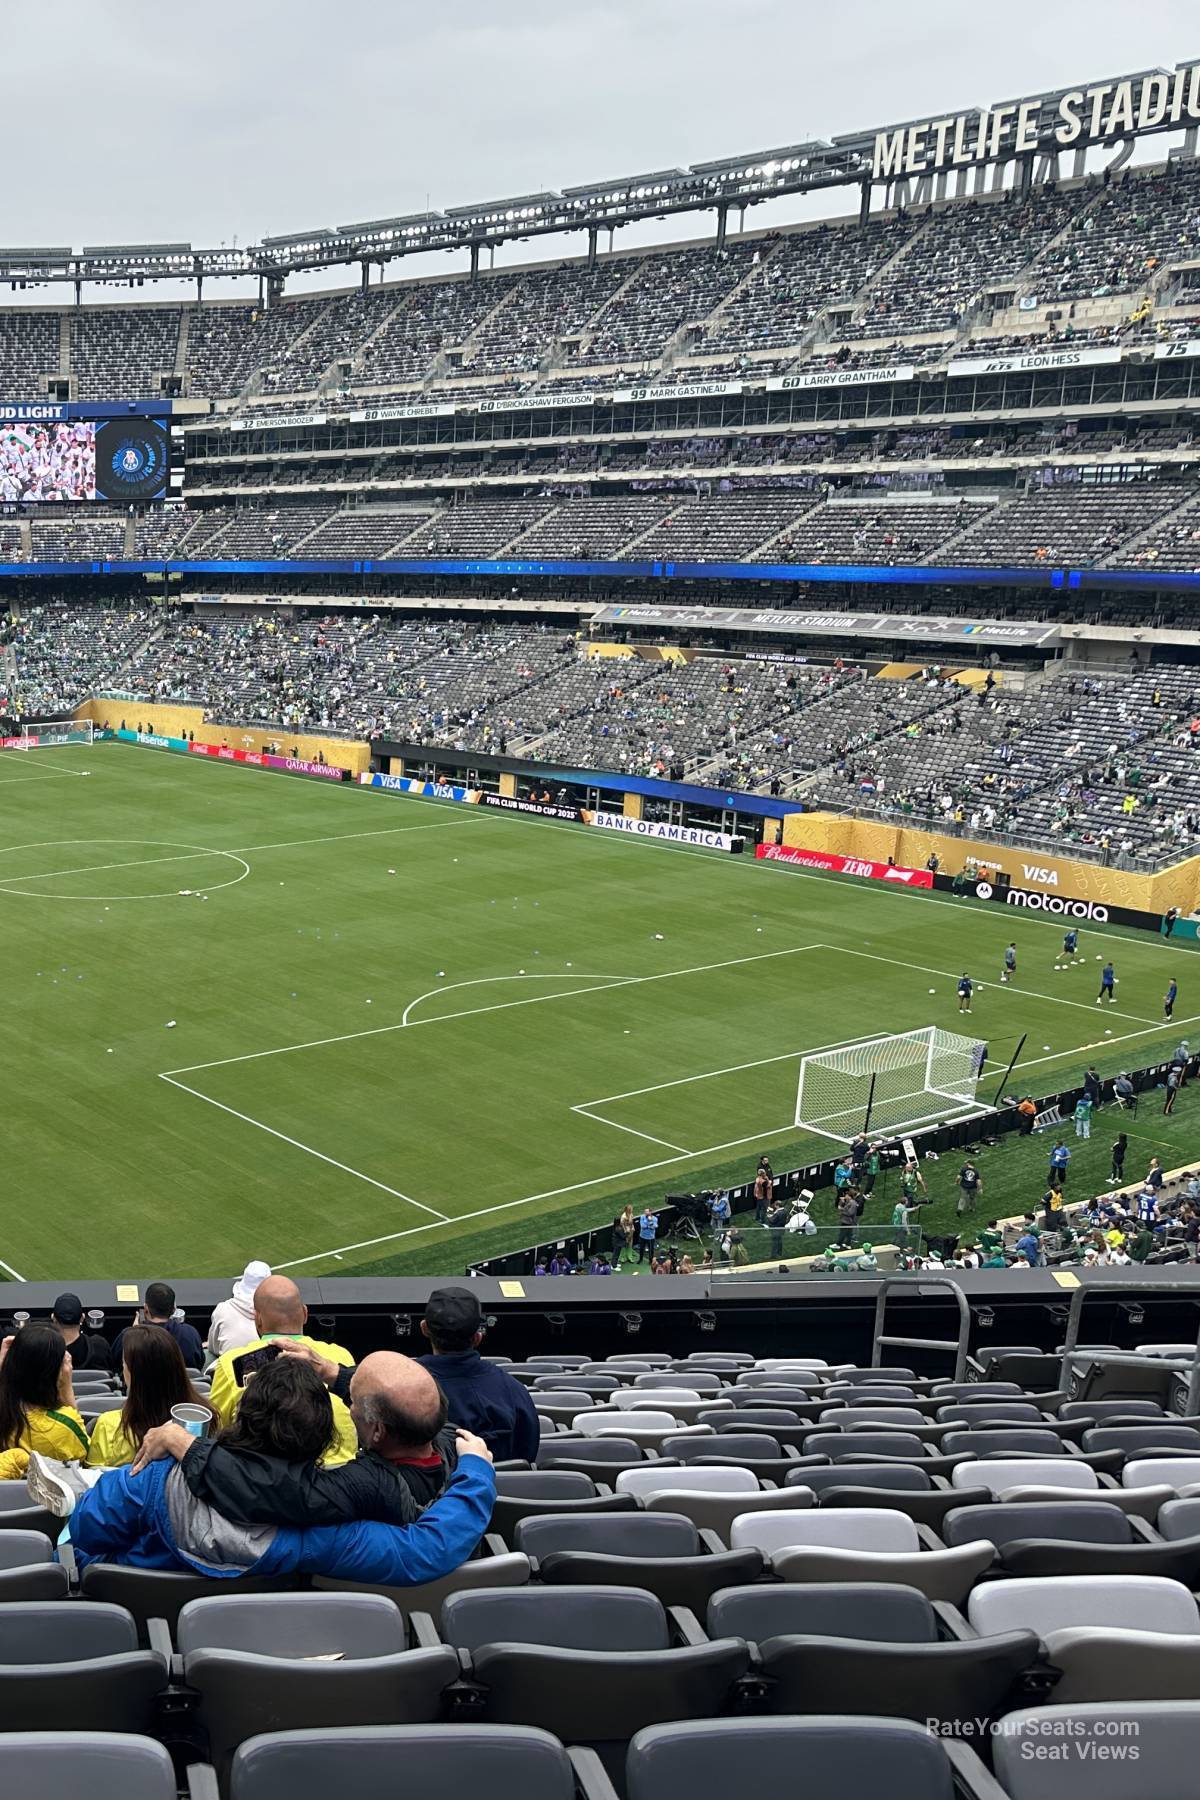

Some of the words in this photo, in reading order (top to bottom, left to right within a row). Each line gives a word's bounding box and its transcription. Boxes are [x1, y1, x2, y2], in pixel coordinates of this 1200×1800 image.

[872, 100, 1043, 180] METLIFE
[1165, 342, 1188, 357] 75
[981, 360, 1015, 373] JETS
[1020, 356, 1053, 369] LEON
[1055, 353, 1081, 365] HESS
[781, 376, 800, 389] 60
[803, 373, 837, 386] LARRY
[838, 368, 898, 384] GRANTHAM
[630, 389, 647, 400] 99
[650, 388, 676, 398] MARK
[677, 384, 727, 396] GASTINEAU
[480, 401, 495, 412] 60
[551, 394, 592, 406] FERGUSON
[18, 406, 63, 418] LIGHT
[364, 410, 378, 420] 80
[380, 408, 406, 418] WAYNE
[406, 406, 439, 417] CHREBET
[242, 419, 254, 429] 32
[255, 418, 287, 428] EMERSON
[287, 416, 314, 426] BOOZER
[628, 608, 662, 617] MetLife
[751, 614, 799, 625] METLIFE
[800, 617, 857, 628] STADIUM
[981, 626, 1029, 636] MetLife
[137, 733, 169, 748] Hisense
[286, 759, 308, 772] QATAR
[311, 764, 341, 777] AIRWAYS
[380, 775, 401, 789] VISA
[432, 784, 454, 799] VISA
[486, 796, 500, 806] FIFA
[501, 798, 518, 809] CLUB
[518, 802, 543, 814] WORLD
[543, 806, 557, 817] CUP
[597, 814, 632, 831] BANK
[637, 823, 654, 834] OF
[658, 825, 723, 847] AMERICA
[763, 845, 833, 870] Budweiser
[966, 855, 1003, 870] Hisense
[841, 860, 873, 878] ZERO
[1021, 863, 1059, 886] VISA
[1007, 889, 1109, 923] motorola
